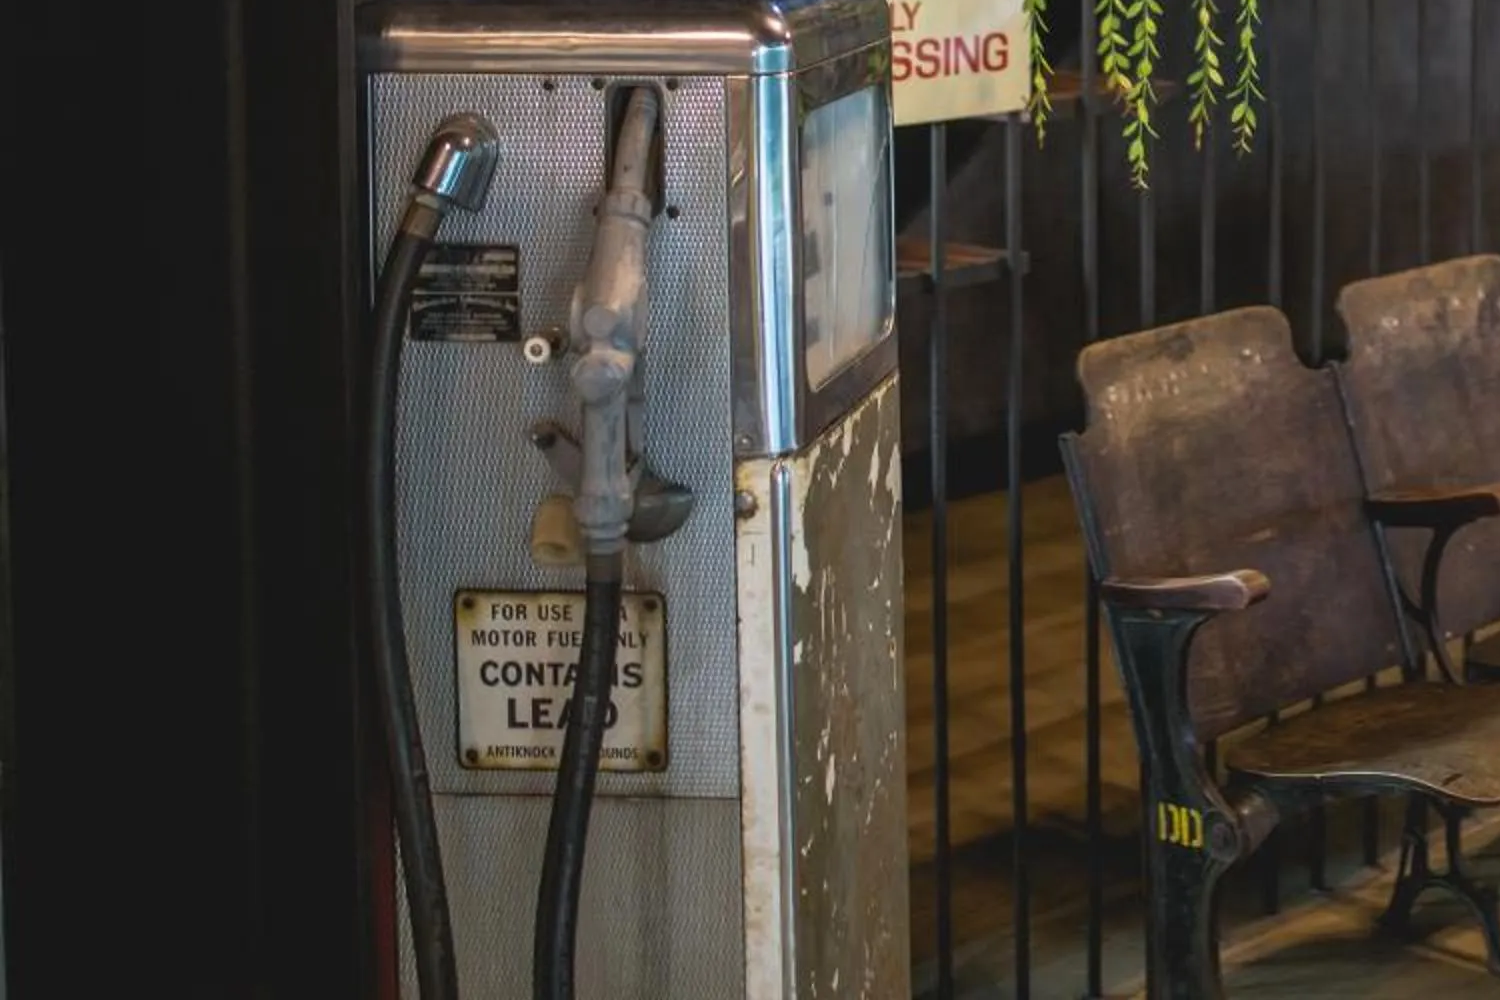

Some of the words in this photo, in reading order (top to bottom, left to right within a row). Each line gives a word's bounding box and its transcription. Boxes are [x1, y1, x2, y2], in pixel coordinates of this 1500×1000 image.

[491, 604, 527, 621] FOR
[538, 604, 573, 621] USE
[471, 630, 537, 647] MOTOR
[547, 631, 584, 647] FUE
[612, 632, 649, 648] NLY
[480, 660, 643, 688] CONTAS
[487, 745, 556, 759] ANTIKNOCK
